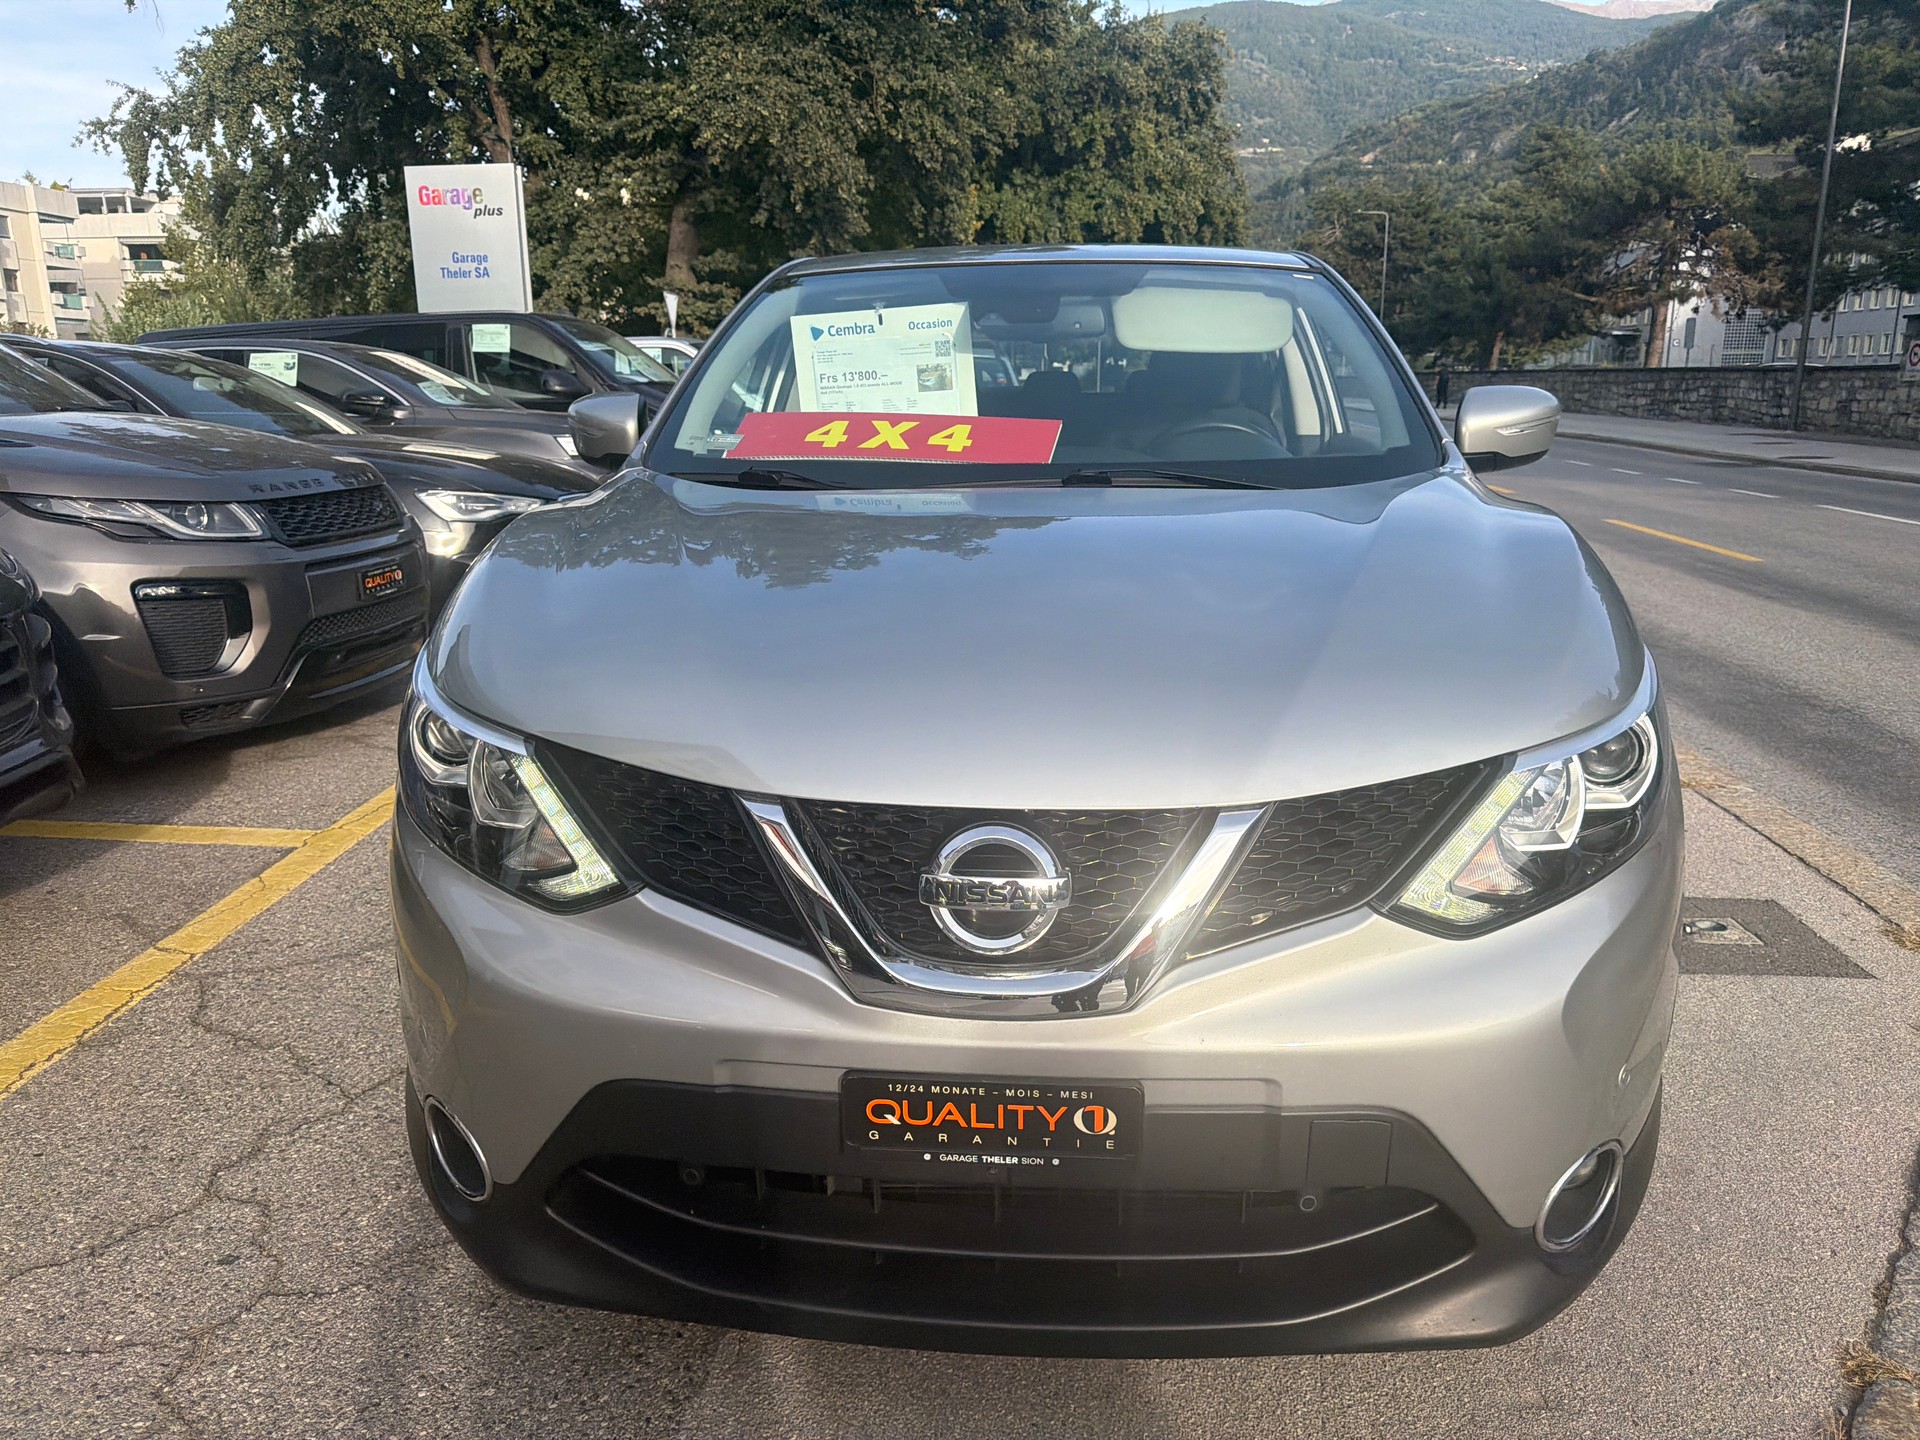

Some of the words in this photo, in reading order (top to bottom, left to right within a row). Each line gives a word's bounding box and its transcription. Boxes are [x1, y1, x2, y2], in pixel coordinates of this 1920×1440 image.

[418, 185, 483, 210] Garage
[474, 205, 503, 219] plus
[452, 251, 488, 265] Garage
[440, 267, 472, 279] Theler
[475, 266, 490, 279] SA
[827, 321, 876, 337] Cembra
[908, 318, 953, 331] Occasion
[820, 373, 838, 383] Frs
[804, 420, 850, 448] 4
[927, 424, 973, 452] 4
[365, 572, 395, 588] QUALITY
[934, 880, 1056, 906] NISSAN
[888, 1083, 924, 1093] 12/24
[931, 1085, 986, 1096] MONATE
[1005, 1088, 1041, 1098] MOIS
[1060, 1090, 1093, 1099] MESI
[865, 1098, 1068, 1131] QUALITY
[868, 1130, 1115, 1150] GARANTIE
[939, 1154, 978, 1163] GARAGE
[981, 1155, 1018, 1164] THELER
[1021, 1157, 1044, 1165] SION
